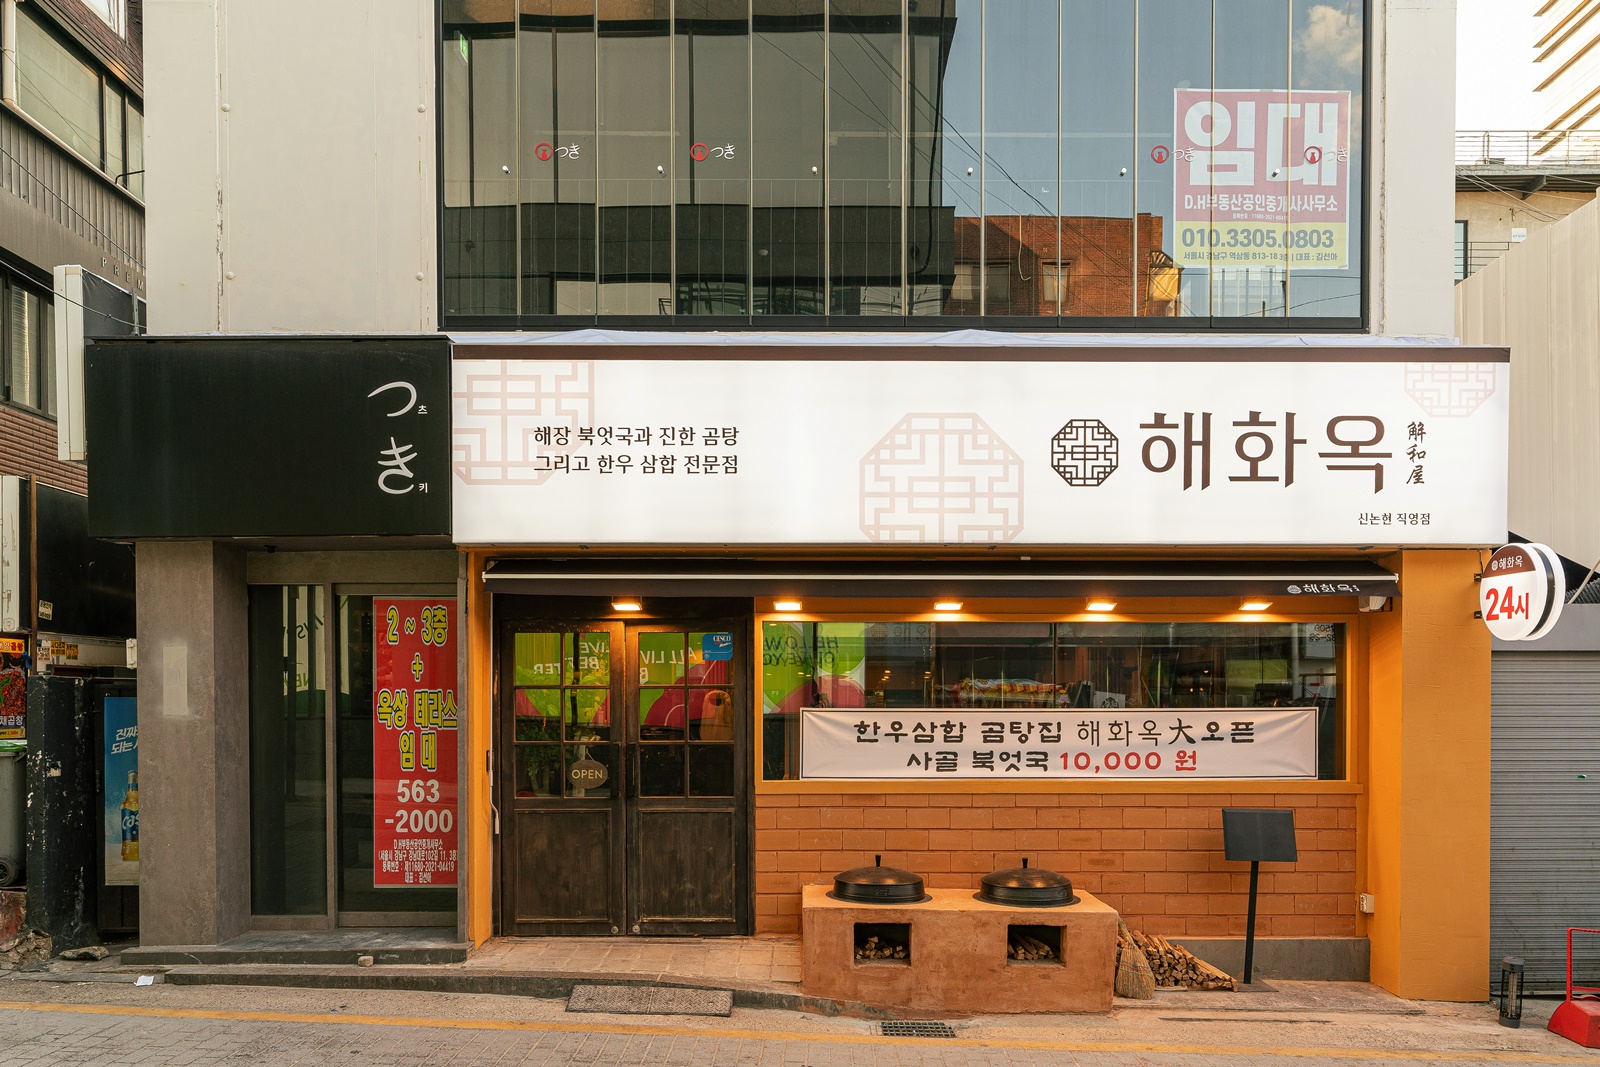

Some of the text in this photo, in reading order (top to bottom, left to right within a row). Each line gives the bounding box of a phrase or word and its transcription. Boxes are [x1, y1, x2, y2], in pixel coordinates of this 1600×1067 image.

[555, 143, 581, 159] つき
[710, 143, 736, 159] つき
[1171, 145, 1195, 162] つき
[1184, 101, 1338, 186] 임대
[1182, 228, 1334, 249] 010.3305.0803
[1183, 252, 1205, 260] 서울시
[1229, 252, 1250, 260] 역삼동
[1296, 253, 1310, 261] 대표
[1316, 252, 1338, 261] 김선아
[533, 426, 740, 447] 해장 북엇국과 진한 곰탕
[1140, 410, 1393, 494] 해화옥
[533, 454, 739, 475] 그리고 한우 삼합 전문점
[418, 482, 428, 494] 키
[1358, 512, 1431, 526] 신논현 직영점
[1499, 555, 1523, 570] 해화옥
[1303, 583, 1353, 594] 해화옥
[1485, 586, 1529, 621] 24시
[387, 606, 399, 644] 2
[421, 605, 447, 646] 3층
[377, 688, 458, 730] 옥상 테라스
[853, 719, 967, 744] 한우삼합
[980, 719, 1062, 744] 곰탕집
[907, 750, 1198, 773] 사골 북엇국 10,000 원
[571, 769, 603, 779] OPEN
[397, 779, 440, 803] 563
[385, 809, 453, 833] -2000
